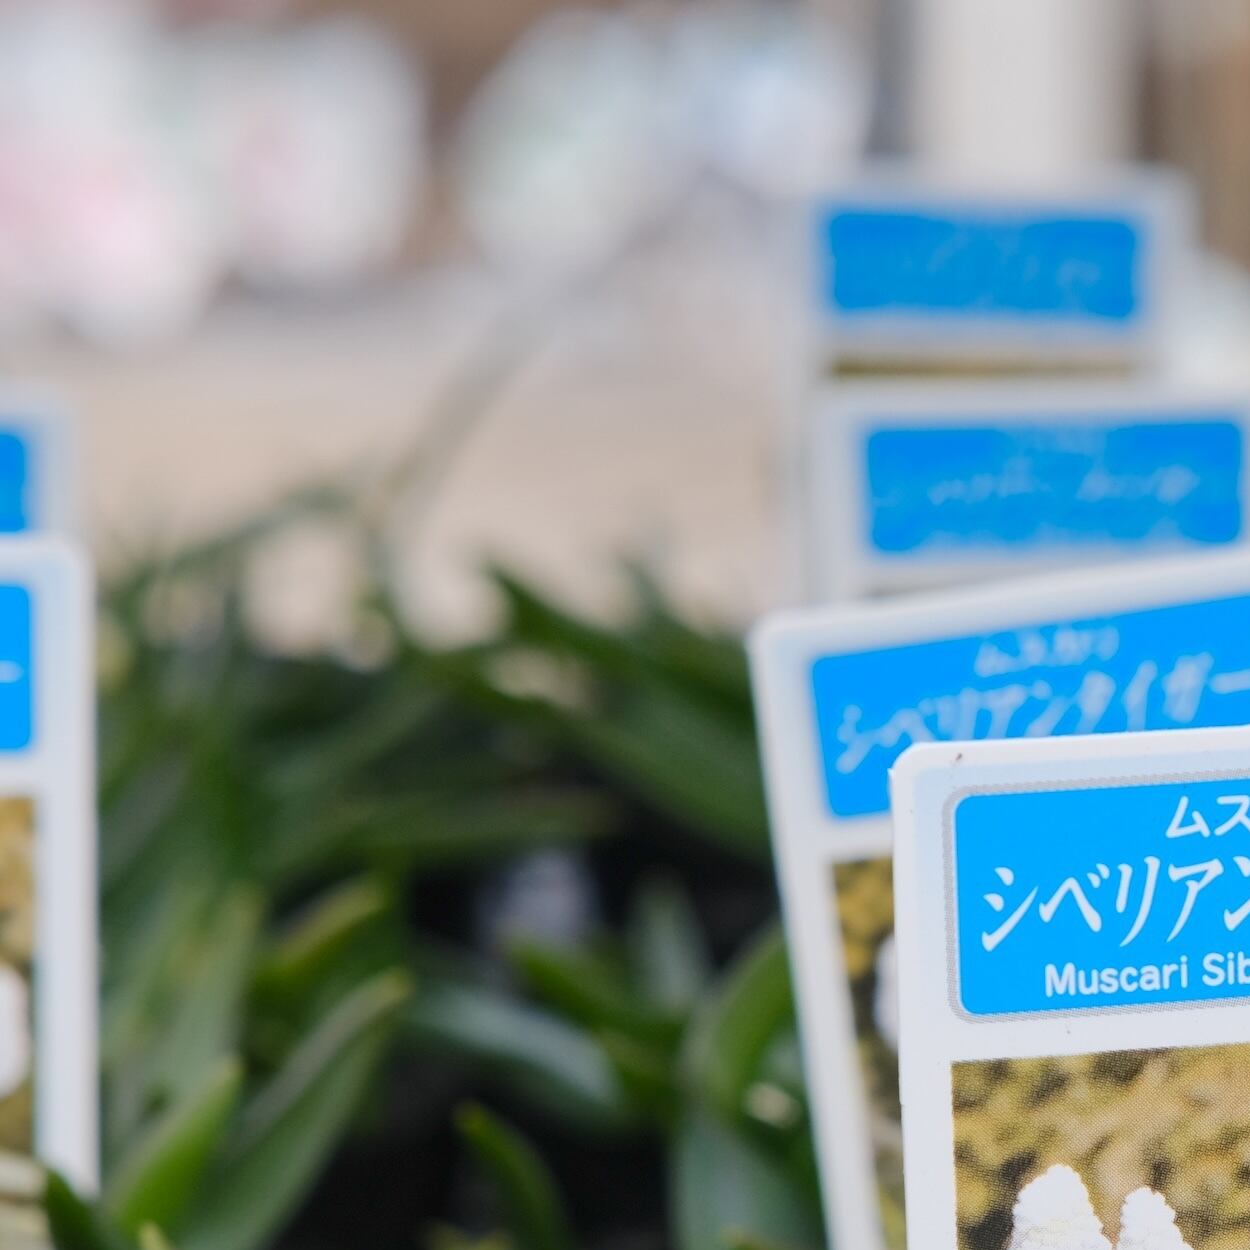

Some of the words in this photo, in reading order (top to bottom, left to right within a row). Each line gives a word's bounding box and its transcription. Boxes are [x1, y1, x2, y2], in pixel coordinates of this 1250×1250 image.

[974, 626, 1120, 677] ムスカリ
[1045, 956, 1189, 998] Muscari
